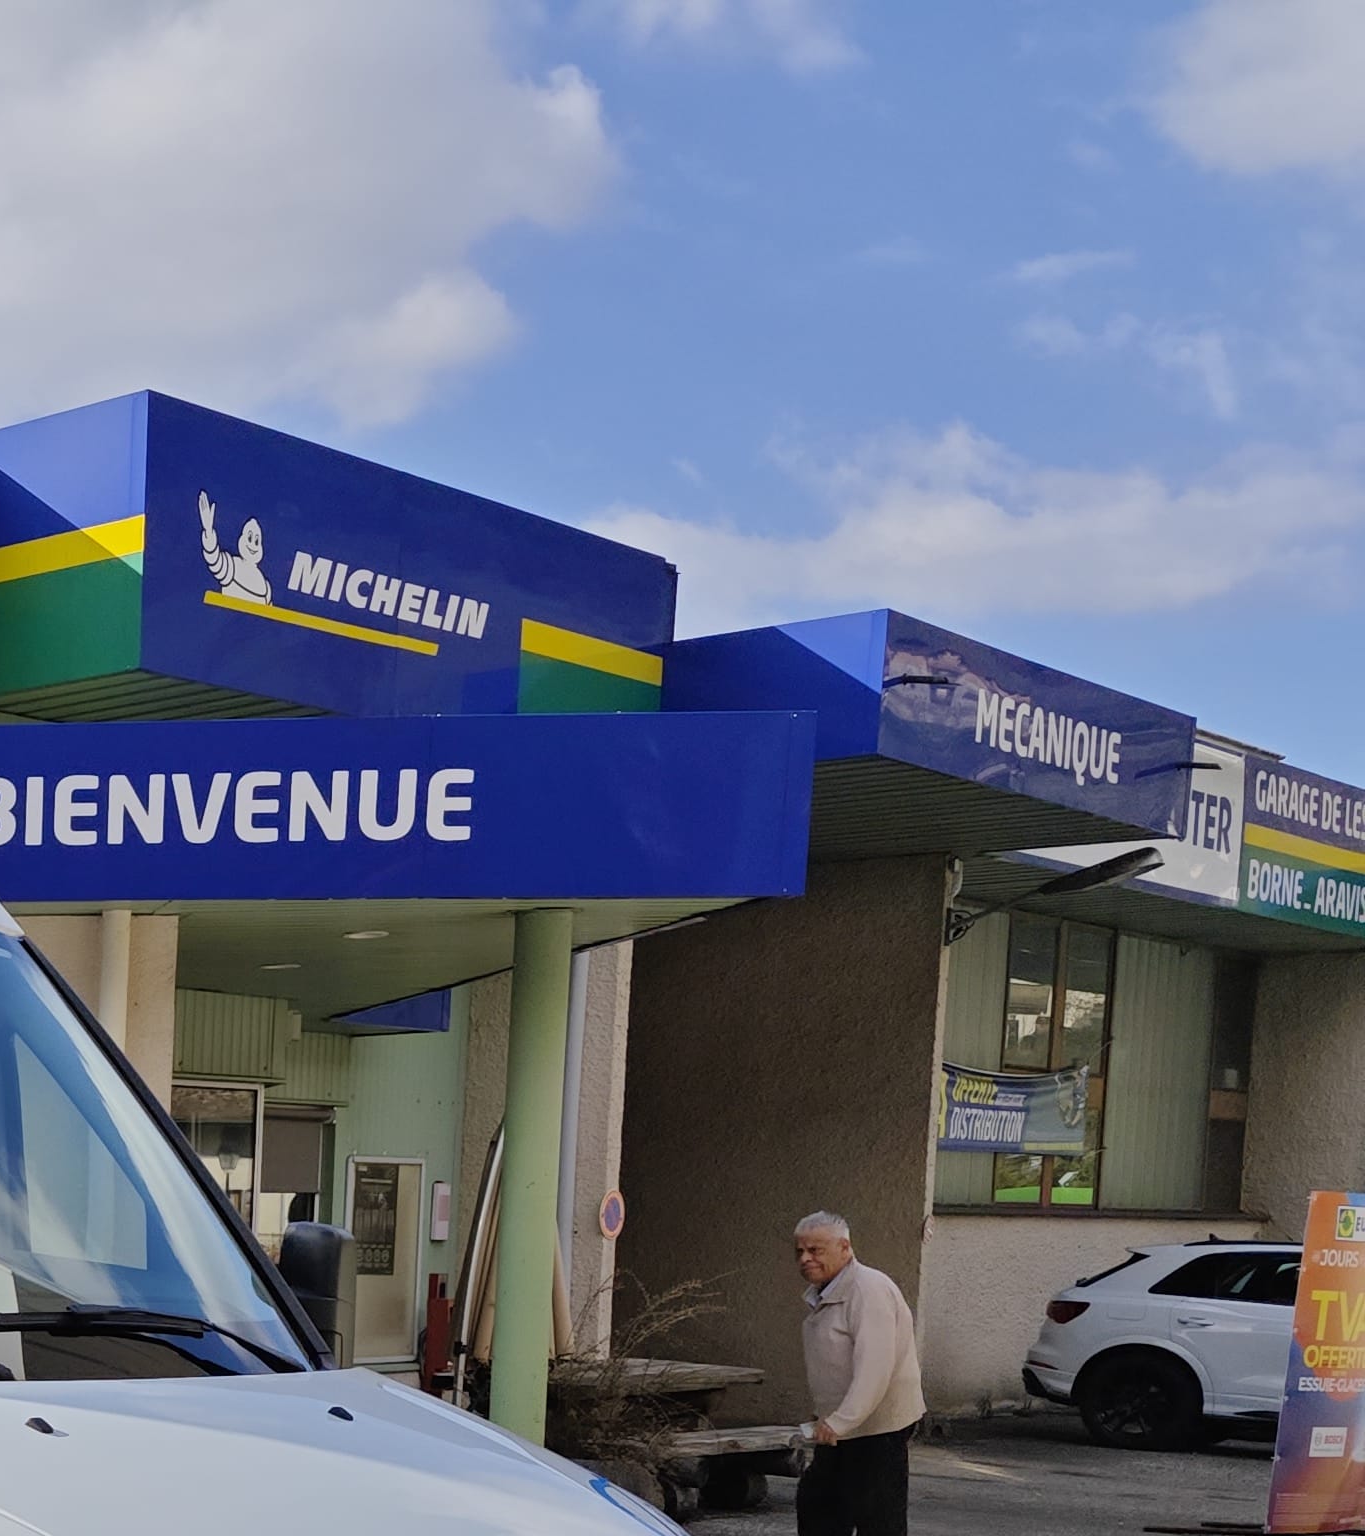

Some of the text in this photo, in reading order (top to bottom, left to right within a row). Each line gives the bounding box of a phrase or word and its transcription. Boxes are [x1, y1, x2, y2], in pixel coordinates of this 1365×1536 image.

[287, 551, 489, 639] MICHELIN
[975, 688, 1121, 786] MECANIQUE
[1255, 770, 1319, 826] GARAGE
[1321, 791, 1342, 833] DE
[949, 1107, 1026, 1143] DISTRIBUTION
